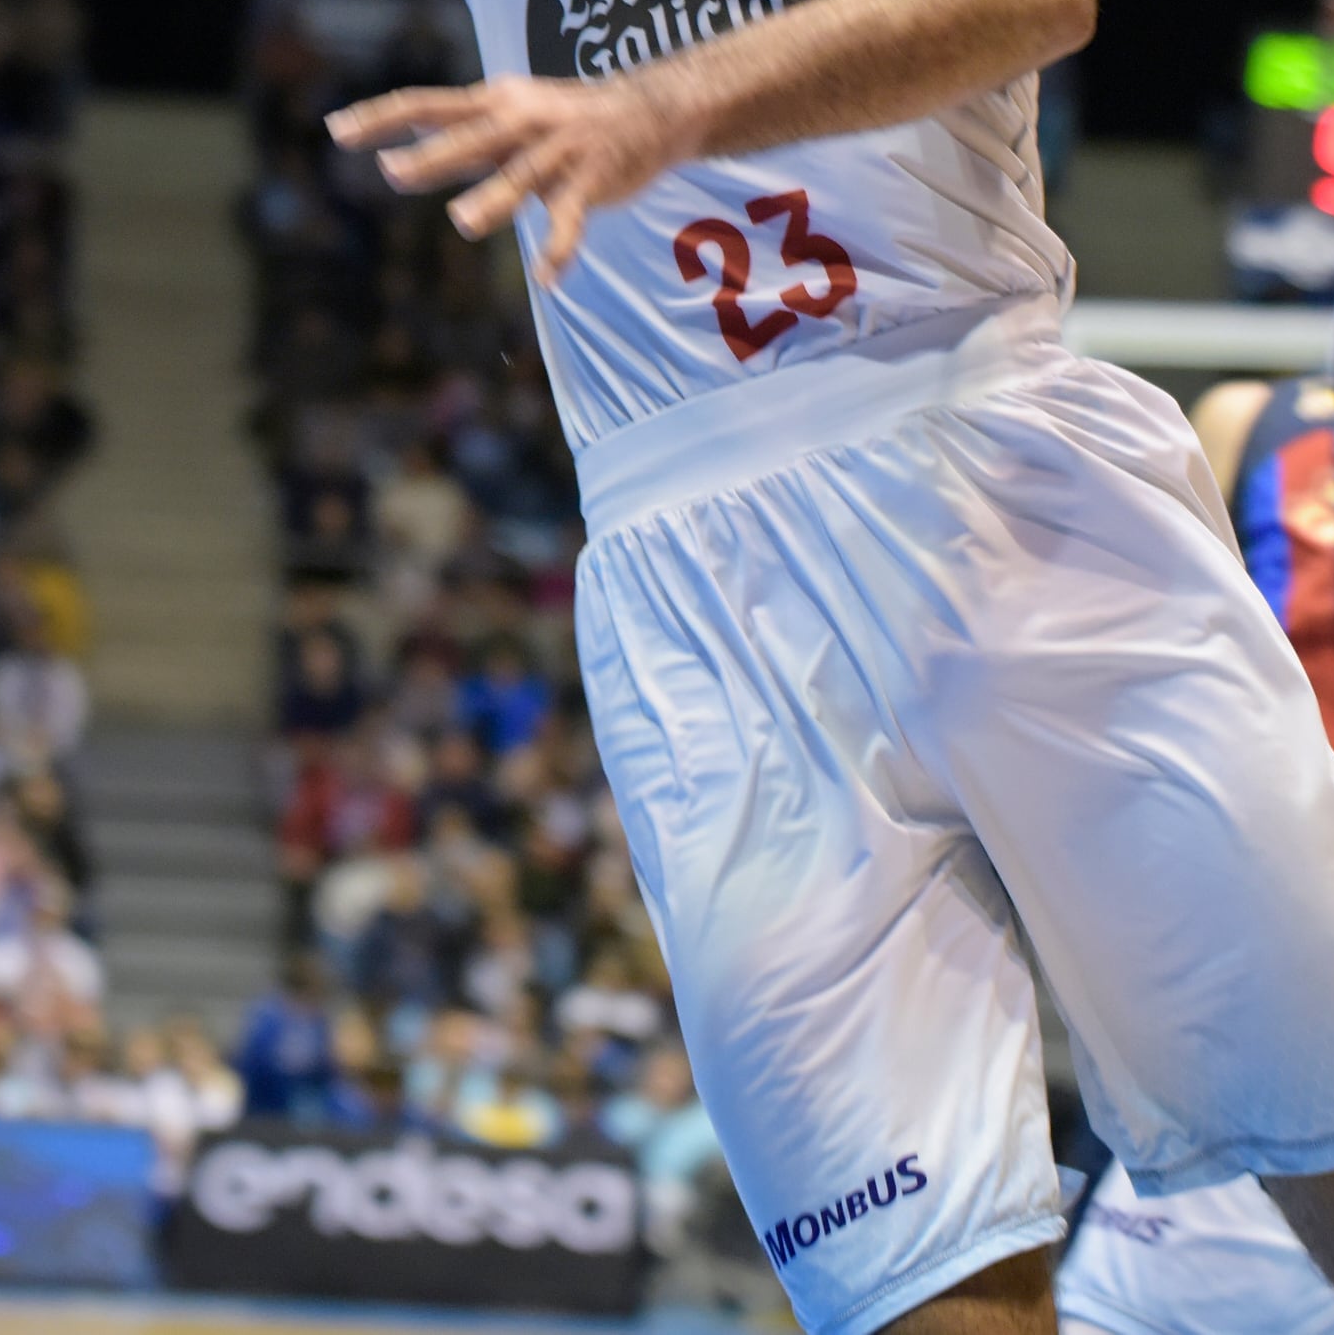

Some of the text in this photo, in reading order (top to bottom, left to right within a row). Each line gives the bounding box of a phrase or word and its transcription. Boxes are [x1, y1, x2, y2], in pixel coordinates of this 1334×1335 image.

[673, 189, 858, 363] 23
[190, 1133, 638, 1254] endesa
[764, 1153, 928, 1271] MONBUS
